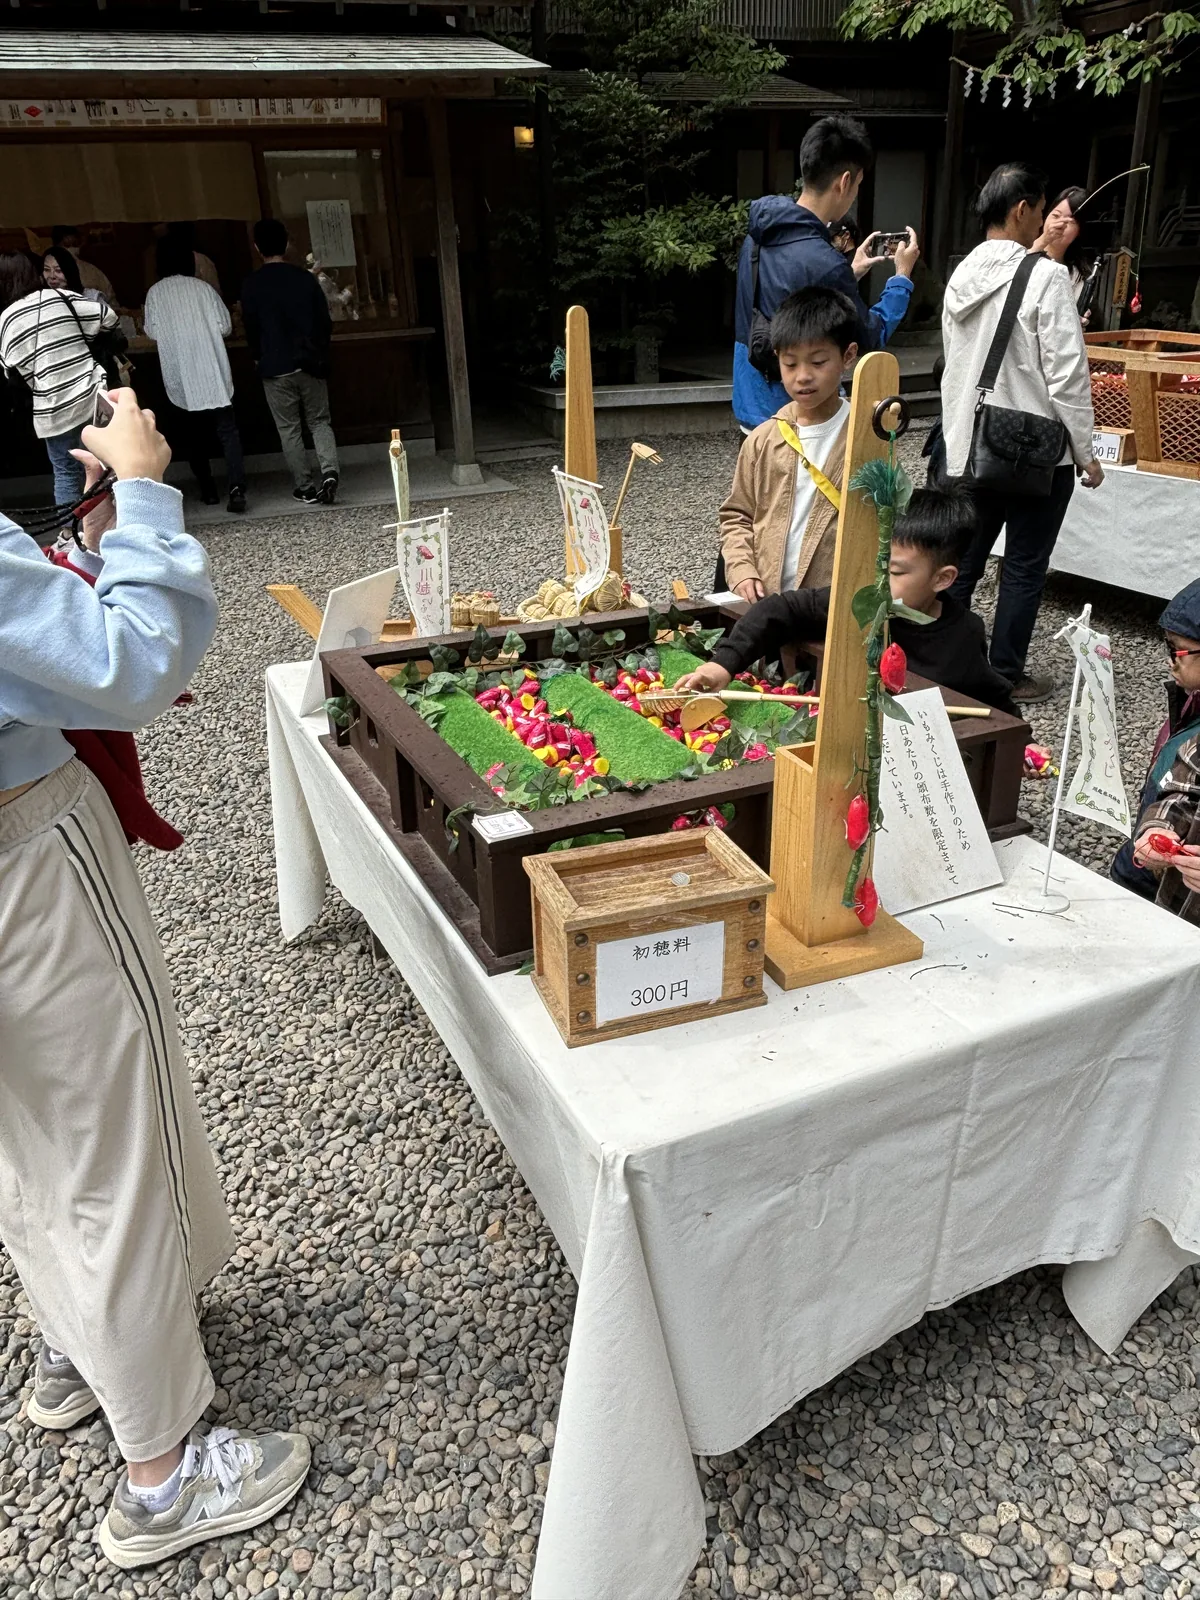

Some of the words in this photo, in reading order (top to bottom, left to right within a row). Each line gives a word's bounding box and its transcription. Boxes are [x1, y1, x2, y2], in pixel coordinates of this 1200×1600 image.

[917, 710, 971, 851] いもみくじは手作りのため
[632, 936, 691, 961] 初穂料
[630, 979, 688, 1007] 300円
